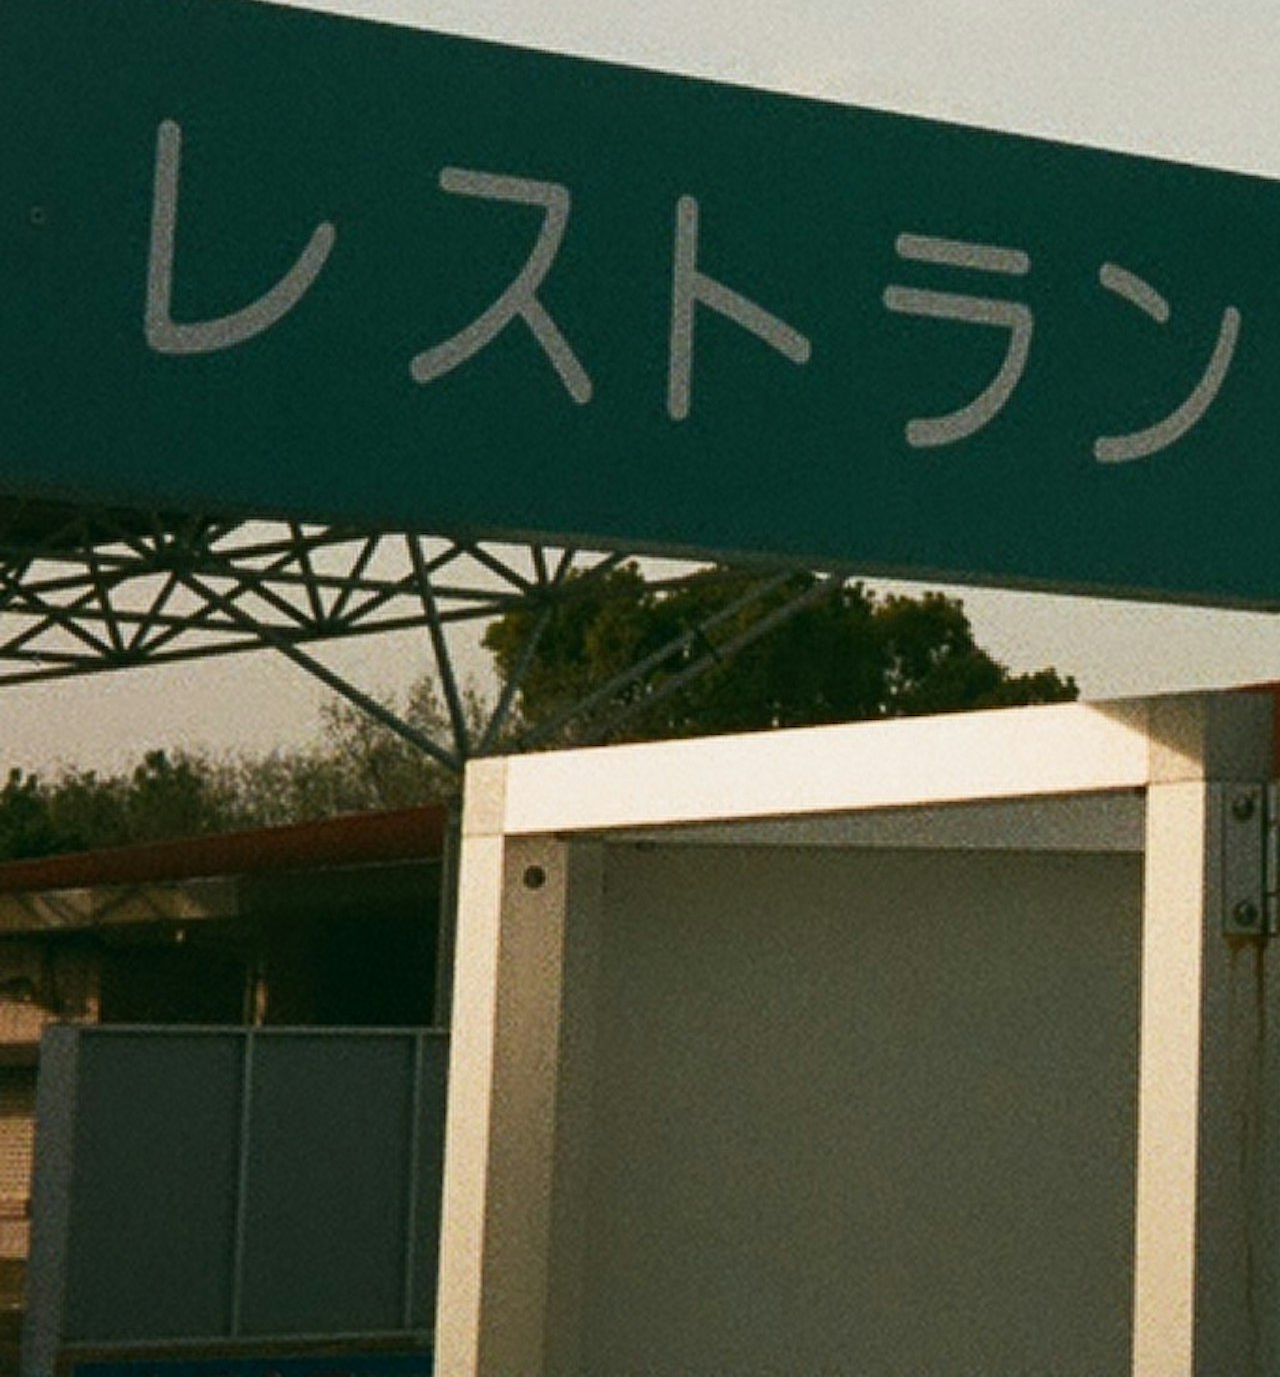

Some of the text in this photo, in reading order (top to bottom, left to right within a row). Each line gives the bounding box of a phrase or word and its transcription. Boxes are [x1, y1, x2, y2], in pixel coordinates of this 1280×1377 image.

[145, 121, 1241, 463] レストラン
